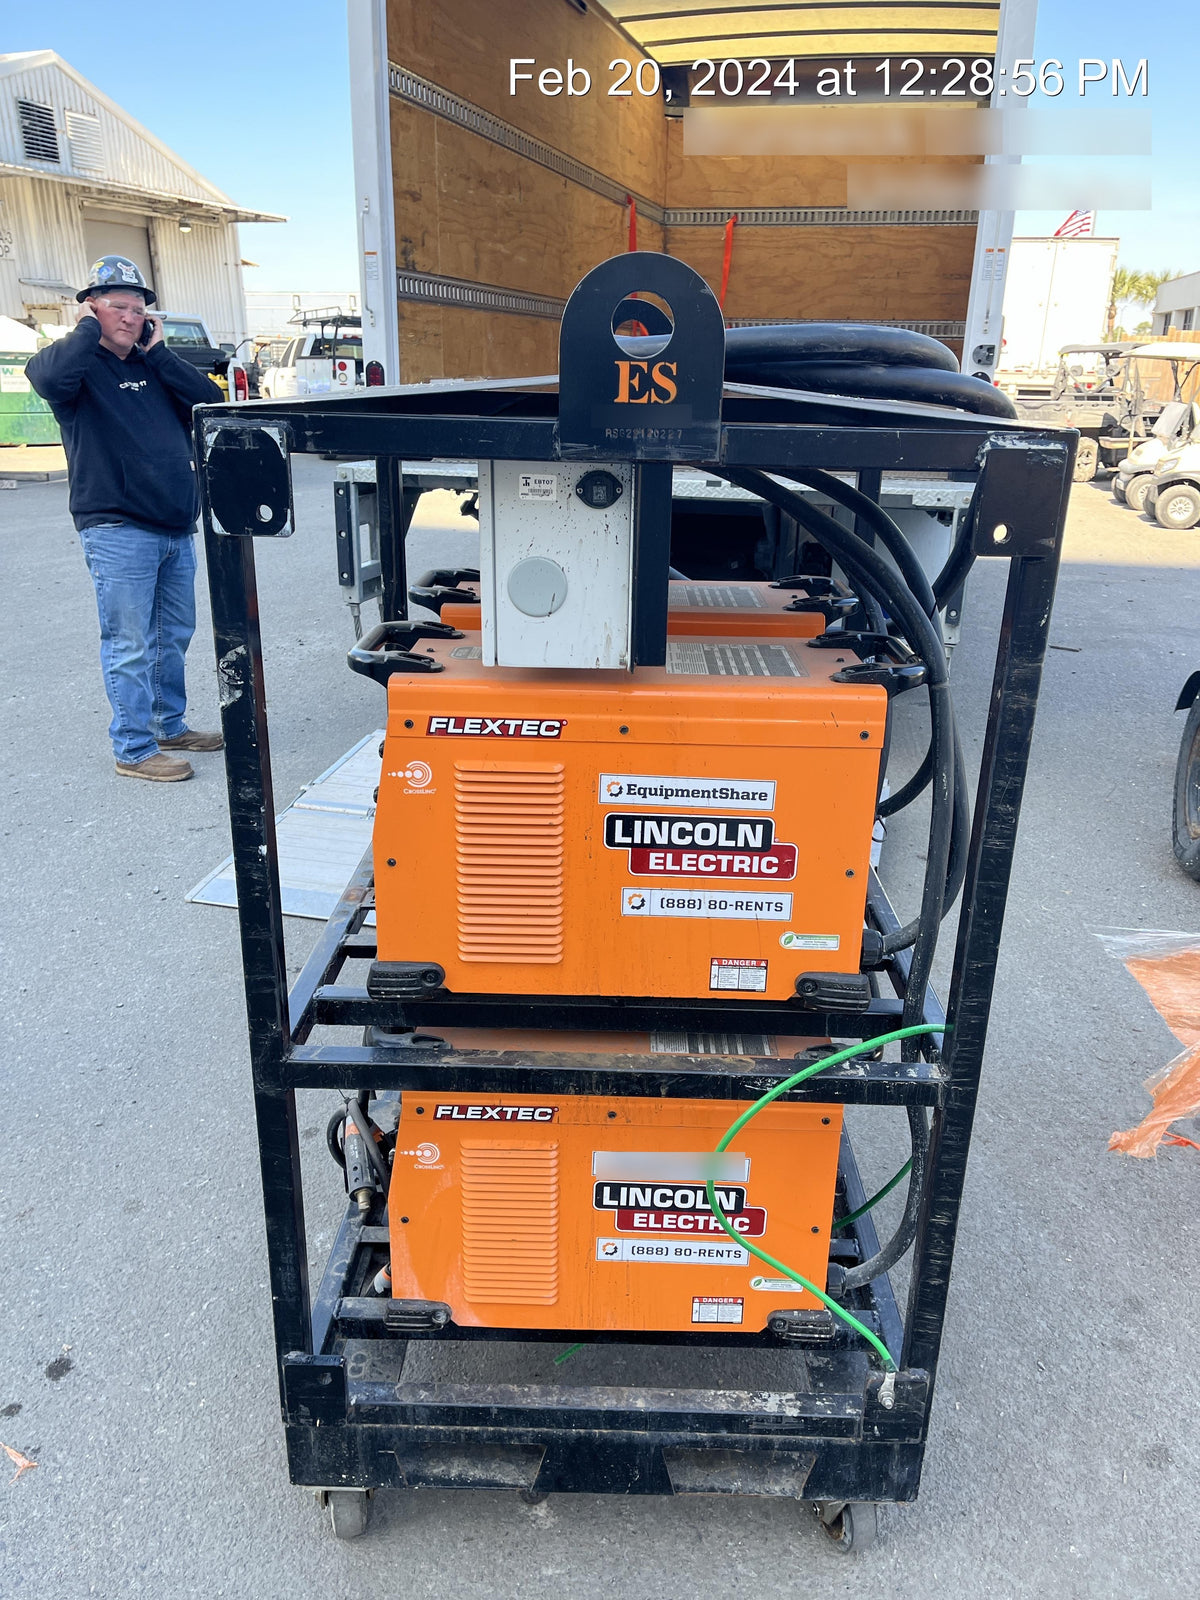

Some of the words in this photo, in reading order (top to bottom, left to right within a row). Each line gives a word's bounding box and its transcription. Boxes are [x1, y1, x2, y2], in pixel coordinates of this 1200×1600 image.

[613, 361, 678, 404] ES
[429, 717, 561, 737] FLEXTEC
[626, 783, 768, 802] EquipmentShare
[614, 819, 763, 848] LINCOLN
[648, 852, 779, 874] ELECTRIC
[660, 897, 702, 909] (888)
[708, 899, 784, 912] 80-RENTS
[436, 1105, 553, 1121] FLEXTEC
[602, 1186, 736, 1211] LINCOLN
[631, 1245, 669, 1256] (888)
[674, 1248, 742, 1259] 80-RENTS
